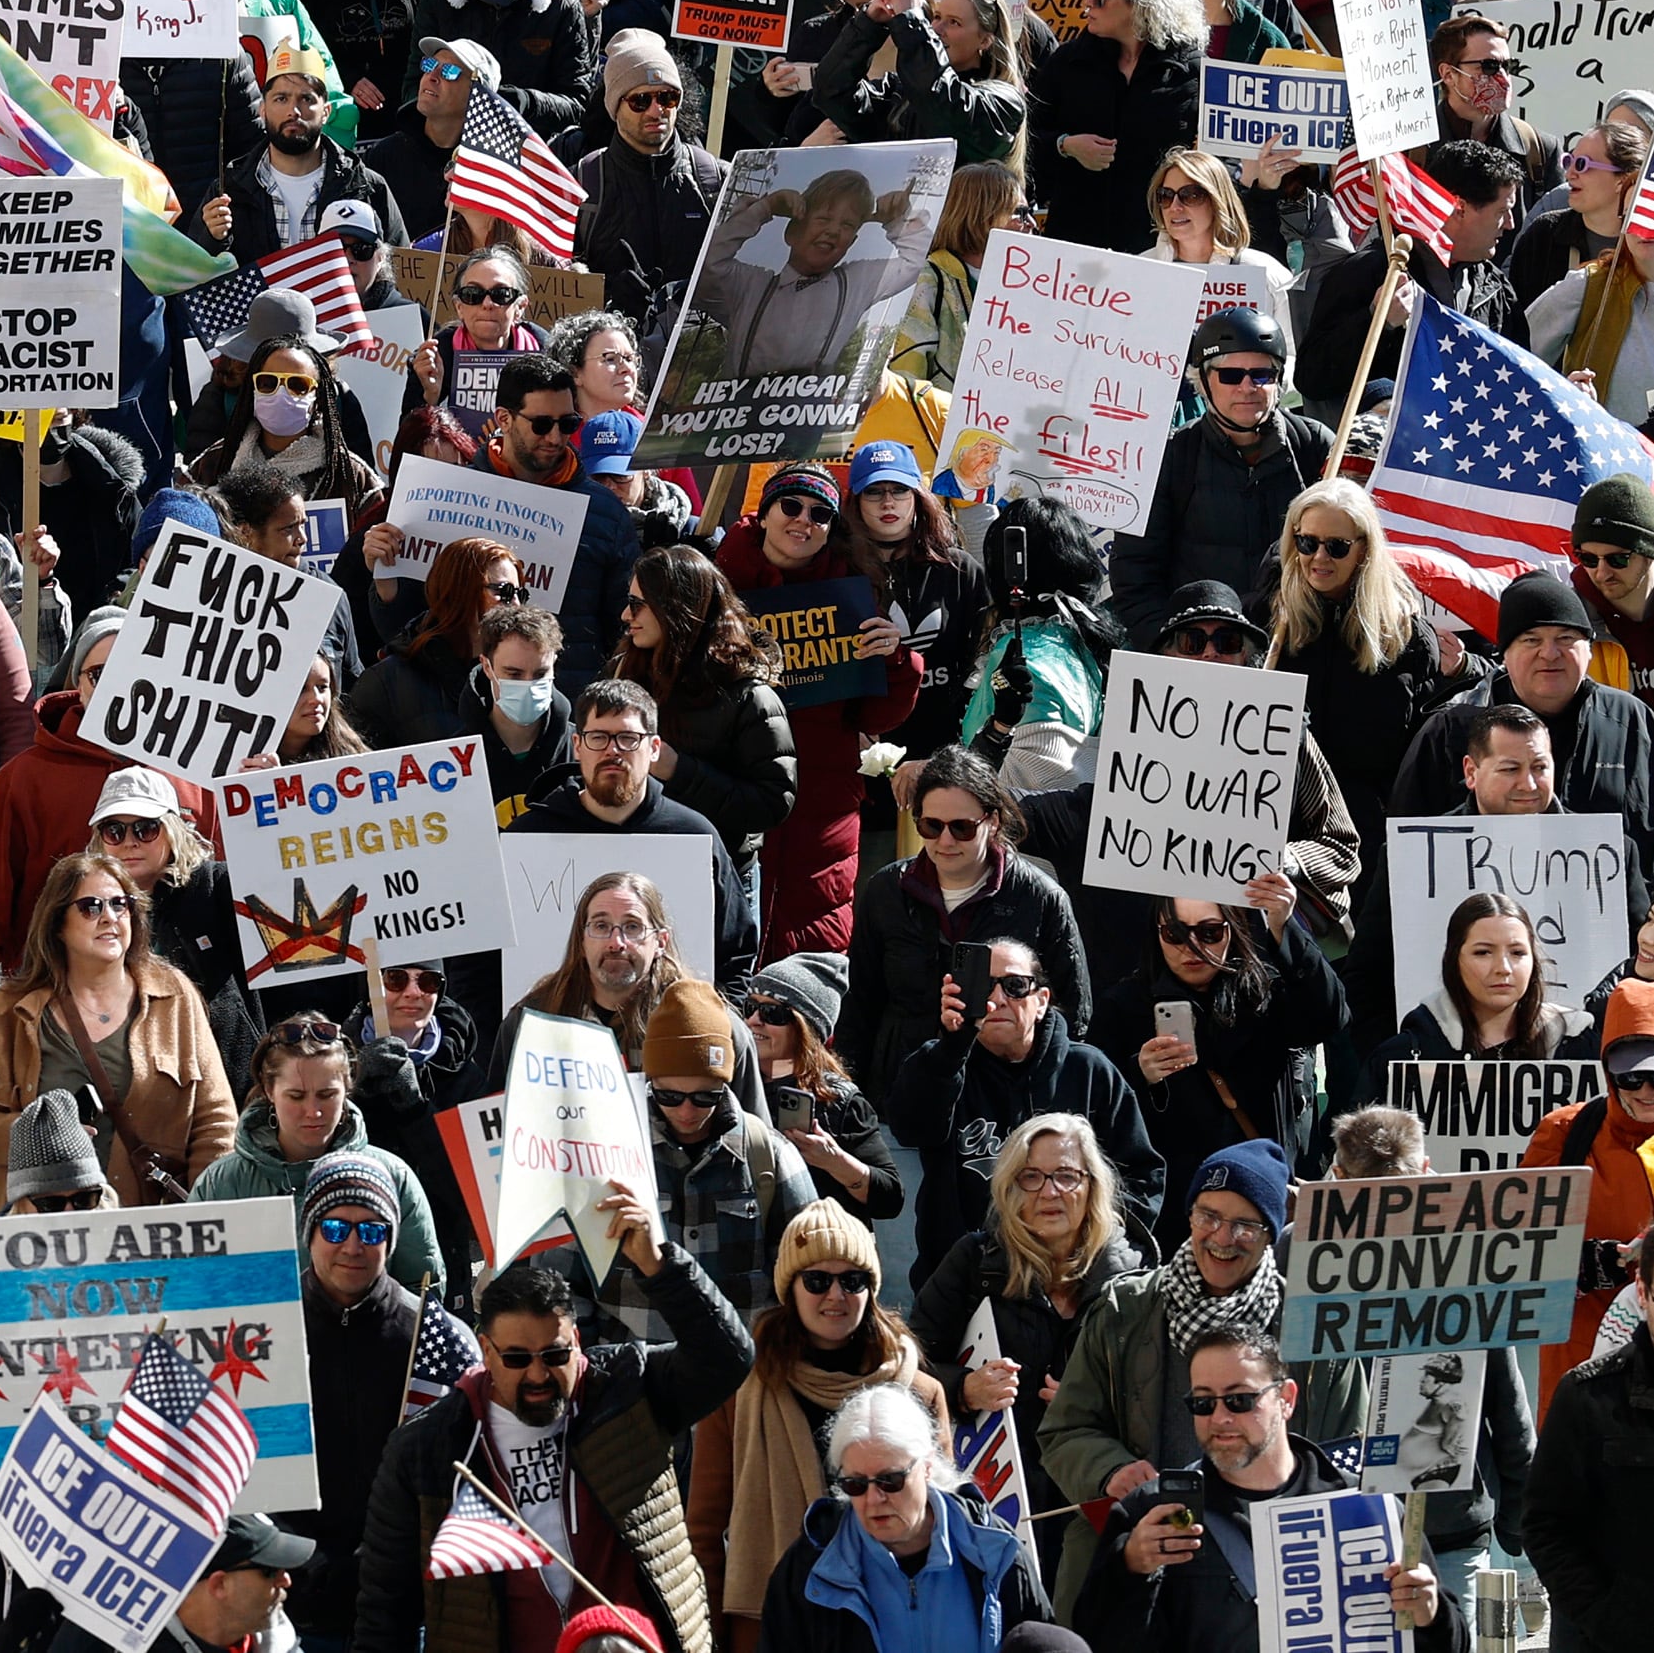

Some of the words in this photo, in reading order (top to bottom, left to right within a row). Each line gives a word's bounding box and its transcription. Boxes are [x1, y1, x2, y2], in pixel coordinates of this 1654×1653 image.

[685, 7, 739, 28] TRUMP
[742, 14, 780, 32] MUST
[698, 24, 722, 39] GO
[724, 26, 763, 45] NOW!
[151, 534, 304, 631] FUCK
[141, 600, 280, 696] THIS
[1130, 678, 1198, 737] NO
[1222, 700, 1294, 756] ICE
[223, 744, 475, 828] DEMOCRACY
[1110, 752, 1172, 805] NO
[1186, 766, 1281, 828] WAR
[280, 812, 448, 870] REIGNS
[1102, 817, 1160, 868] NO
[384, 870, 419, 896] NO
[375, 905, 466, 939] KINGS!
[1309, 1178, 1570, 1241] IMPEACH
[1307, 1231, 1556, 1294] CONVICT
[1314, 1288, 1540, 1354] REMOVE
